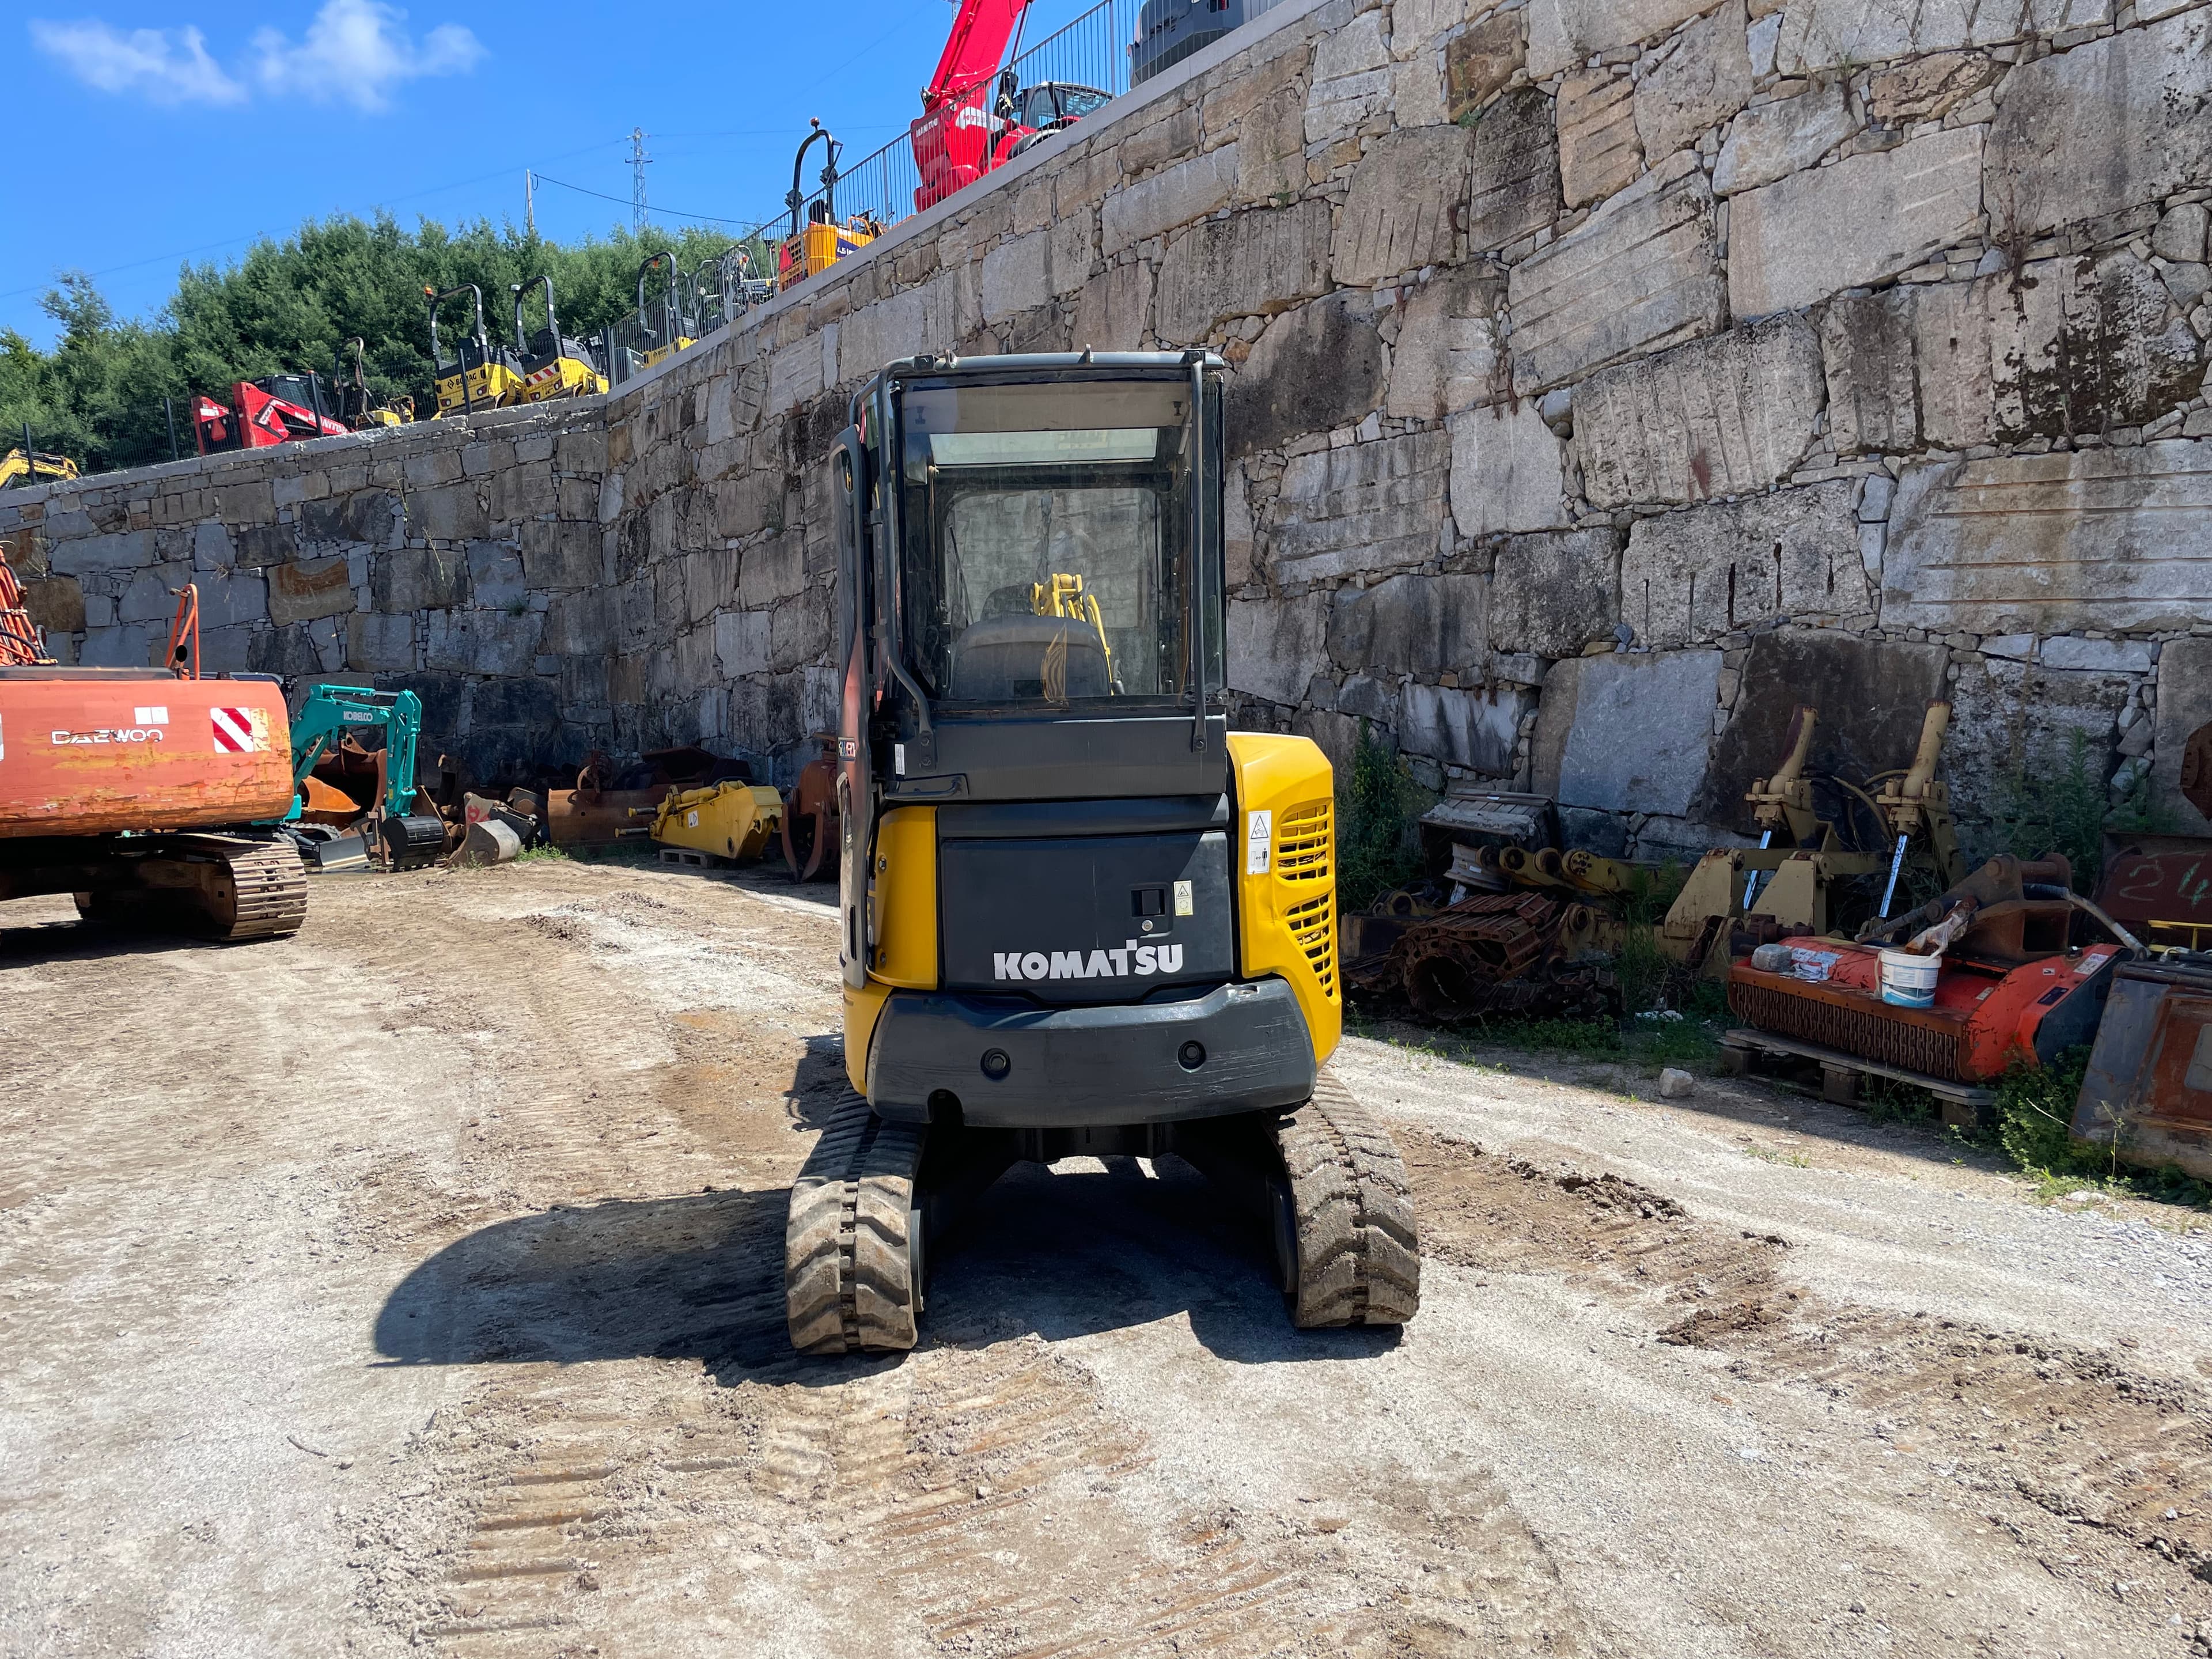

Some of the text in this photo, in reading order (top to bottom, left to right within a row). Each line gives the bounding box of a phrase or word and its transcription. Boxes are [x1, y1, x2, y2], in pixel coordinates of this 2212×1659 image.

[343, 711, 373, 722] KOBELCO
[51, 729, 164, 744] DAEWOO
[993, 939, 1183, 980] KOMATSU
